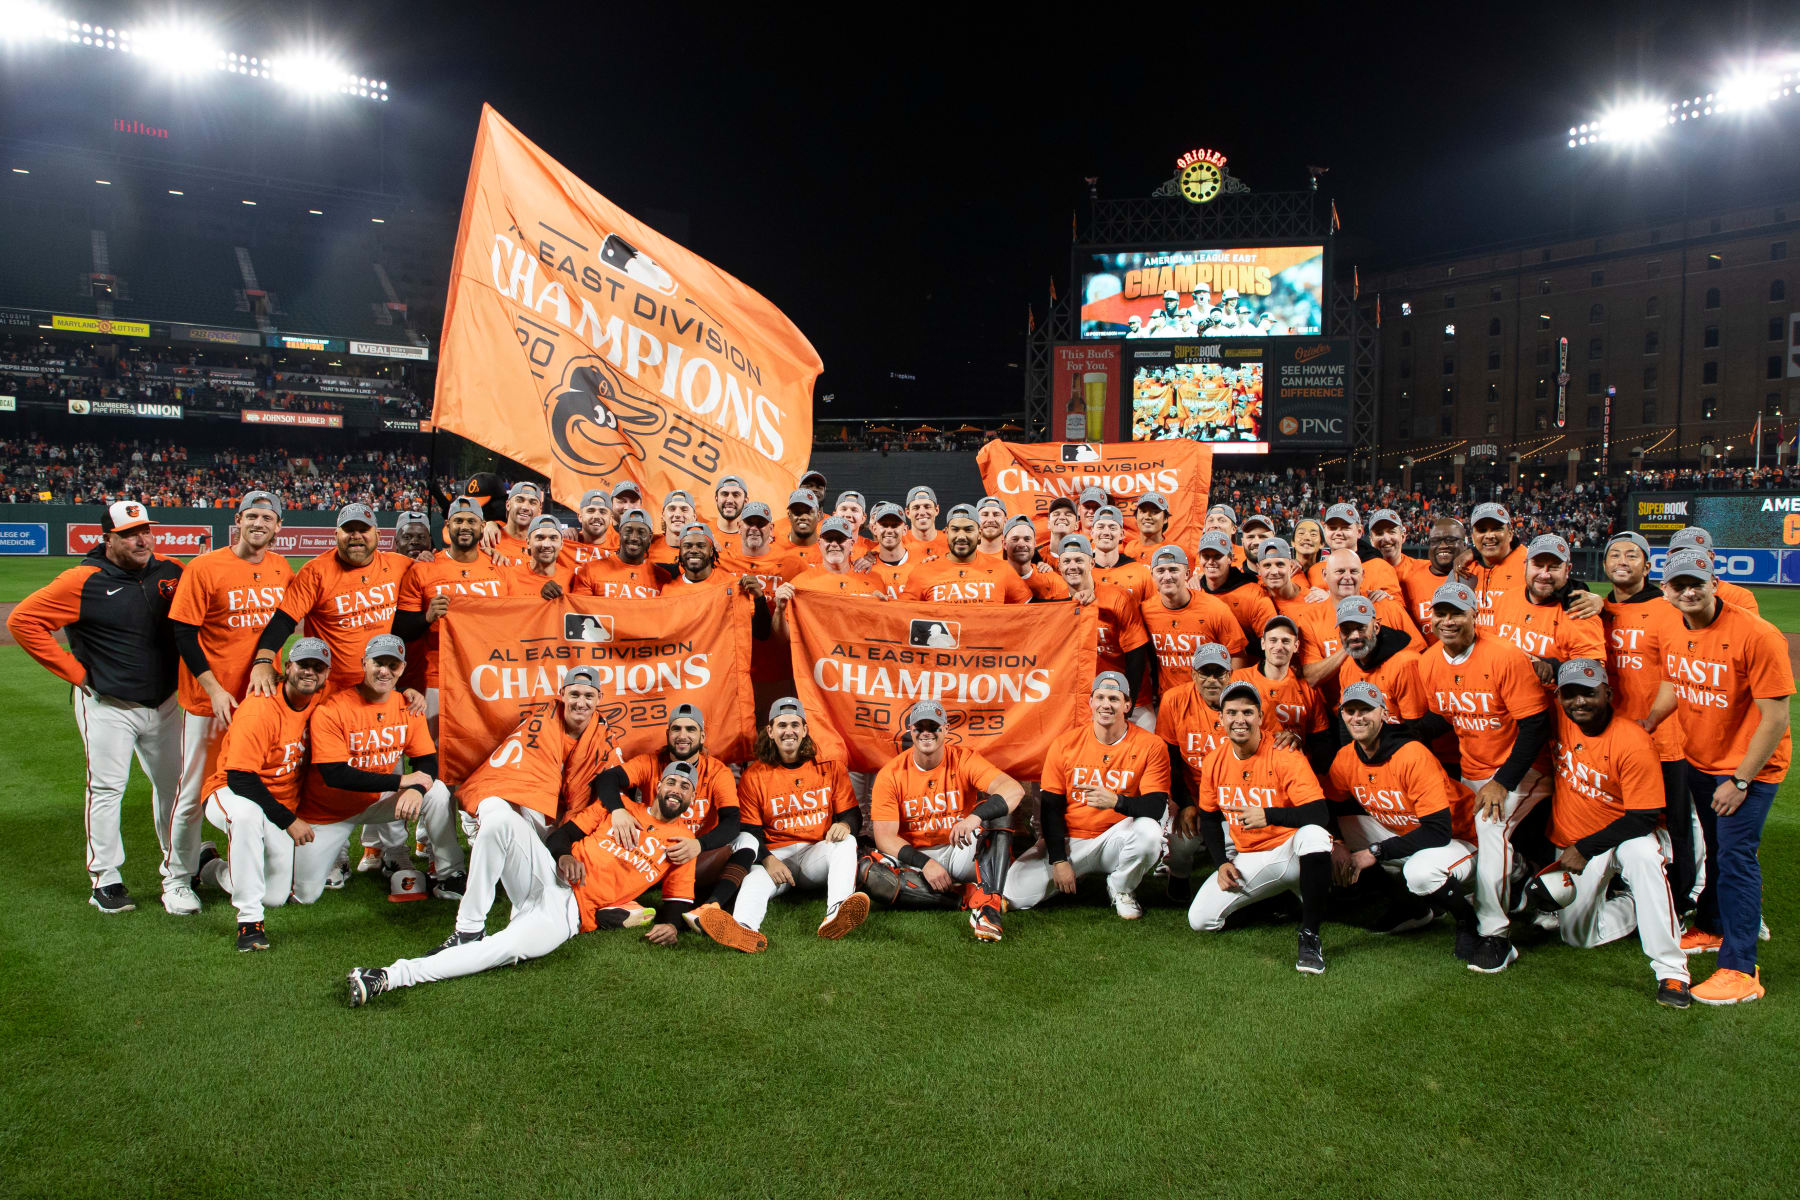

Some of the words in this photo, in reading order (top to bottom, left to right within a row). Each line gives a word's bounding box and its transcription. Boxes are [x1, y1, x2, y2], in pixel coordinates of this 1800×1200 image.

[114, 119, 169, 138] Hilton
[1177, 148, 1227, 169] ORIOLES
[1144, 255, 1192, 266] AMERICAN
[1195, 254, 1230, 264] LEAGUE
[1233, 254, 1257, 264] EAST
[1124, 264, 1272, 299] CHAMPIONS
[9, 319, 31, 327] ESTATE
[538, 241, 626, 302] EAST
[633, 293, 763, 386] DIVISION
[57, 319, 97, 329] MARYLAND
[113, 325, 145, 334] LOTTERY
[286, 341, 325, 351] CHAMPIONS
[357, 344, 390, 355] WBAL
[490, 233, 784, 462] CHAMPIONS
[1060, 349, 1085, 360] This
[1087, 348, 1115, 360] Bud's
[1174, 344, 1221, 358] SUPERBOOK
[1295, 344, 1331, 361] Orioles
[1066, 360, 1084, 371] For
[1086, 360, 1108, 371] You.
[1281, 366, 1301, 375] SEE
[1302, 365, 1327, 375] HOW
[1328, 365, 1345, 375] WE
[1281, 377, 1302, 386] CAN
[1304, 377, 1334, 386] MAKE
[1335, 377, 1344, 386] A
[1280, 388, 1345, 398] DIFFERENCE
[92, 401, 129, 409] PLUMBERS
[109, 407, 136, 415] FITTERS
[137, 403, 181, 416] UNION
[262, 414, 296, 423] JOHNSON
[298, 416, 326, 425] LUMBER
[1301, 418, 1343, 434] PNC
[663, 426, 721, 474] 23
[1032, 465, 1076, 473] EAST
[1083, 459, 1165, 473] DIVISION
[997, 468, 1180, 498] CHAMPIONS
[1638, 501, 1688, 516] SUPERBOOK
[1650, 553, 1755, 576] GCO
[227, 587, 286, 611] EAST
[334, 582, 397, 615] EAST
[933, 582, 995, 602] EAST
[242, 607, 276, 615] DIVISIO
[1611, 628, 1645, 650] ST
[489, 648, 519, 662] AL
[526, 646, 586, 661] EAST
[592, 641, 694, 660] DIVISION
[831, 644, 861, 659] AL
[868, 648, 930, 664] EAST
[936, 654, 1038, 668] DIVISION
[813, 657, 1051, 704] CHAMPIONS
[1666, 654, 1728, 687] EAST
[1435, 691, 1494, 714] EAST
[630, 704, 668, 722] 23
[855, 706, 891, 726] 20
[968, 716, 1005, 730] 23
[1275, 703, 1306, 723] ST
[349, 724, 409, 752] EAST
[1072, 767, 1135, 790] EAST
[770, 786, 832, 817] EAST
[903, 790, 960, 818] EAST
[1217, 786, 1277, 808] EAST
[1353, 786, 1406, 811] EAST
[785, 807, 823, 818] DIVISION
[598, 838, 659, 884] CHAMPS
